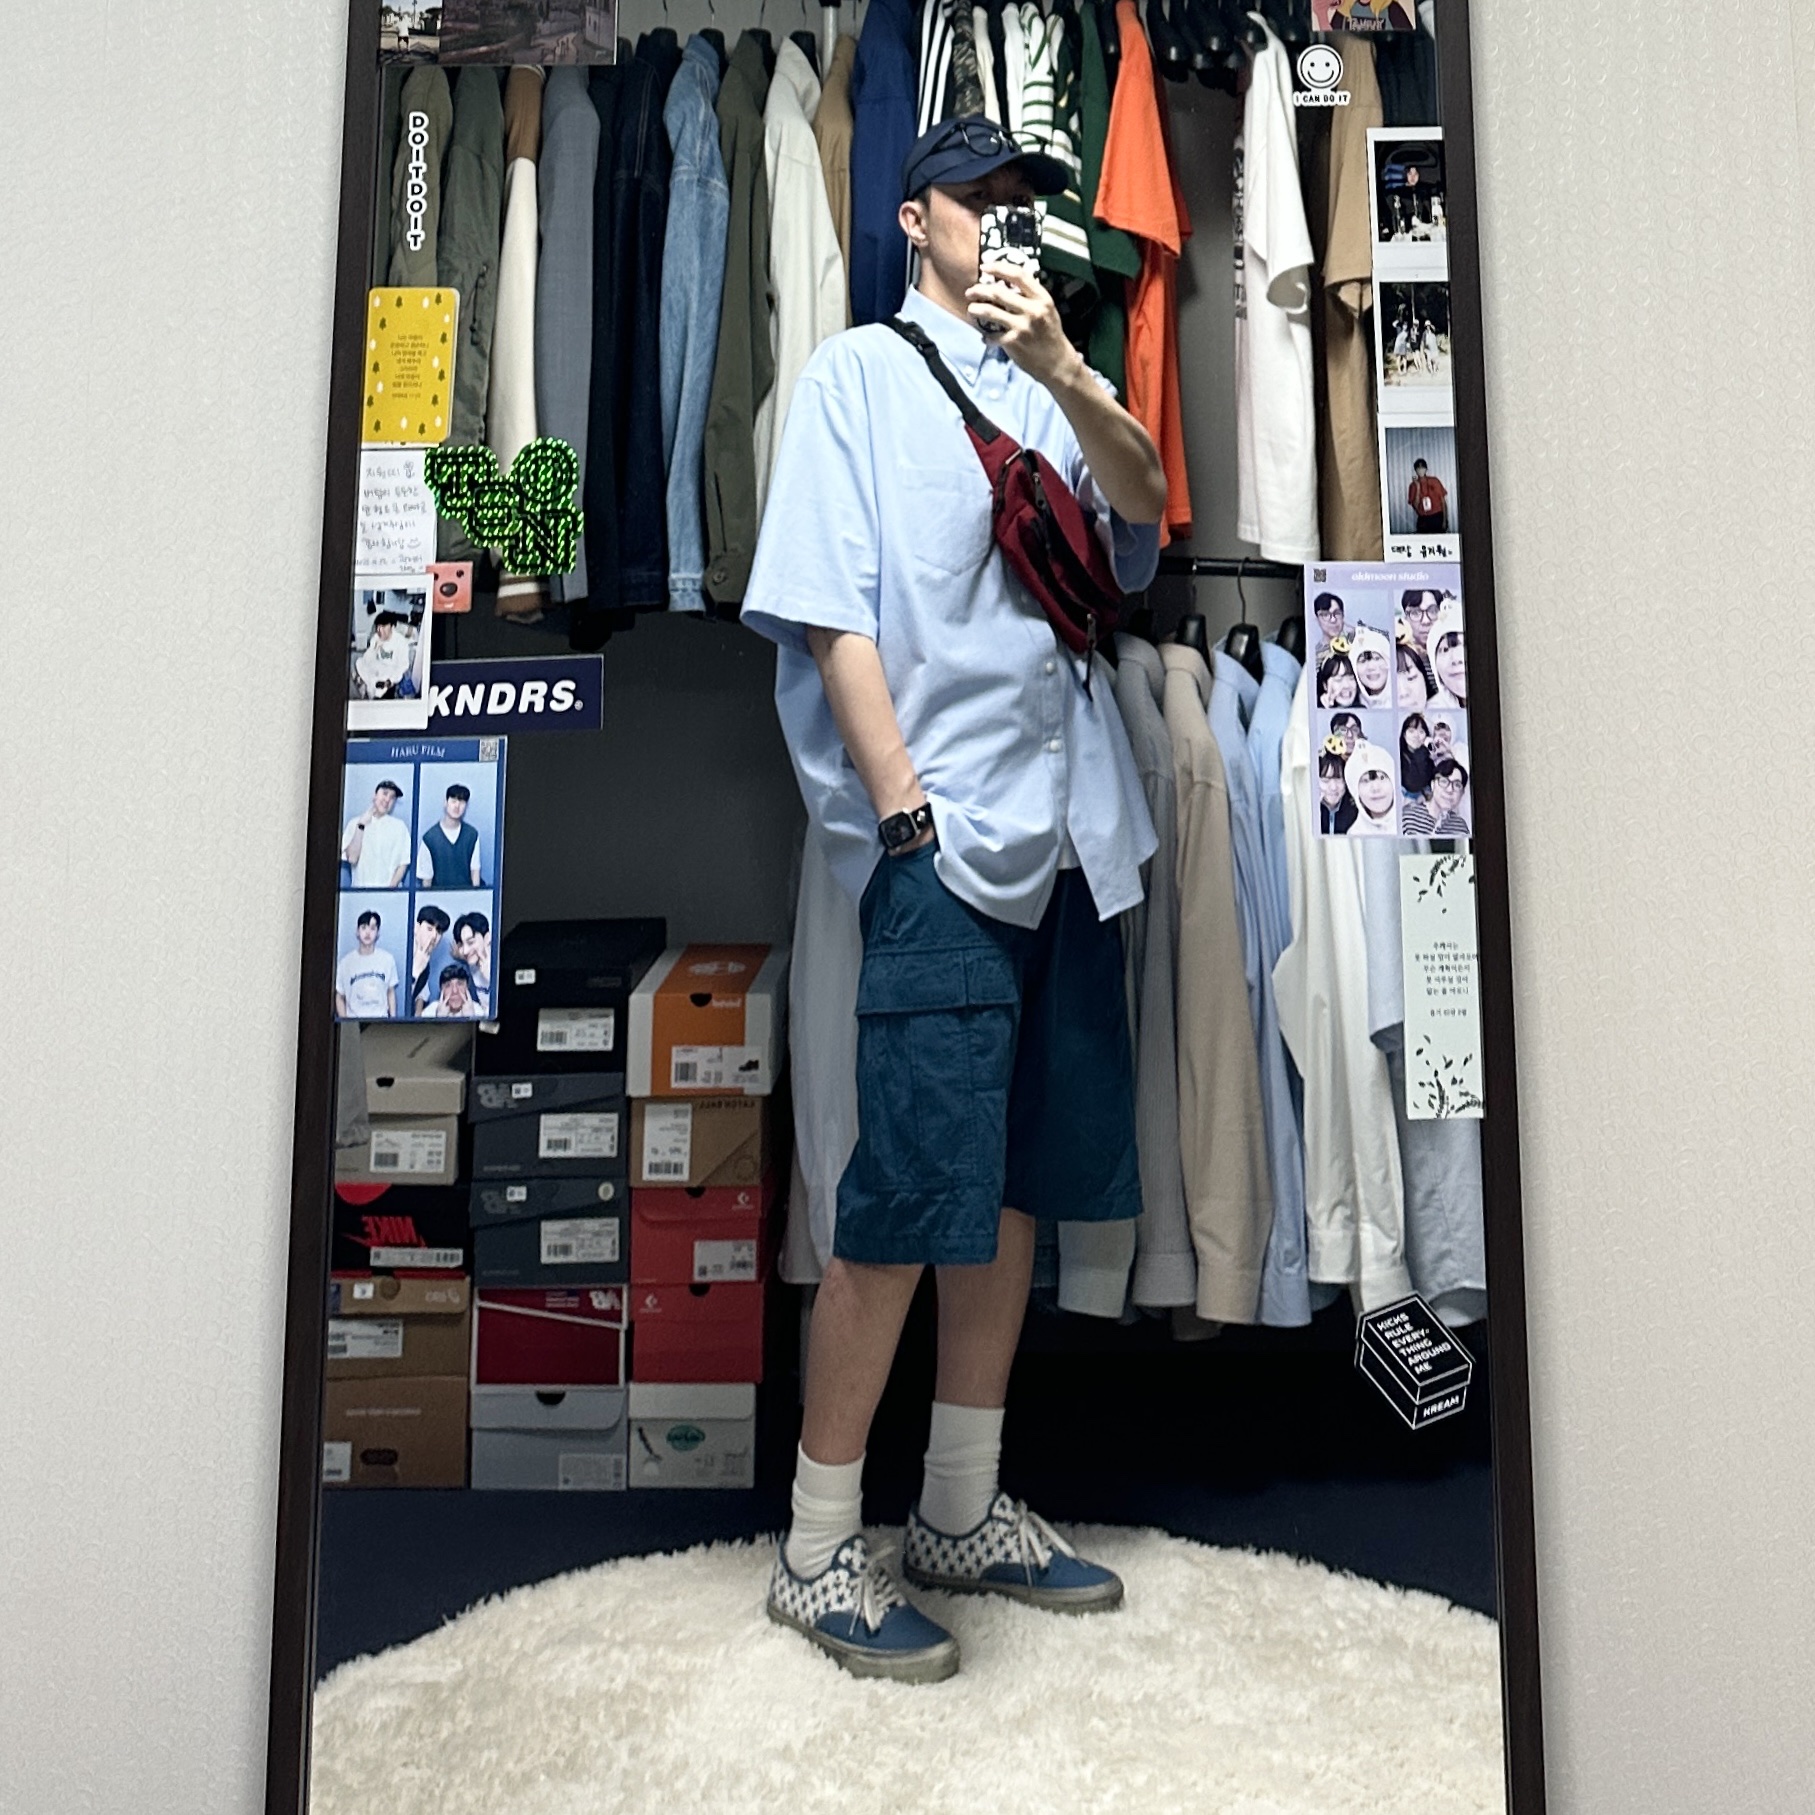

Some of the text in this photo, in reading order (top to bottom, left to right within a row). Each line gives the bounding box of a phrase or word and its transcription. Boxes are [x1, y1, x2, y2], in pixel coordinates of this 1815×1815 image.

[1302, 94, 1320, 103] CAN
[1323, 94, 1335, 103] DO
[1338, 94, 1348, 103] IT
[391, 744, 446, 758] HARU FILM
[1377, 1312, 1409, 1331] KICKS
[1384, 1322, 1413, 1340] RULE
[1399, 1338, 1432, 1356] THING
[1408, 1342, 1451, 1366] AROUND
[1414, 1361, 1432, 1375] ME
[1423, 1395, 1459, 1417] KREAM
